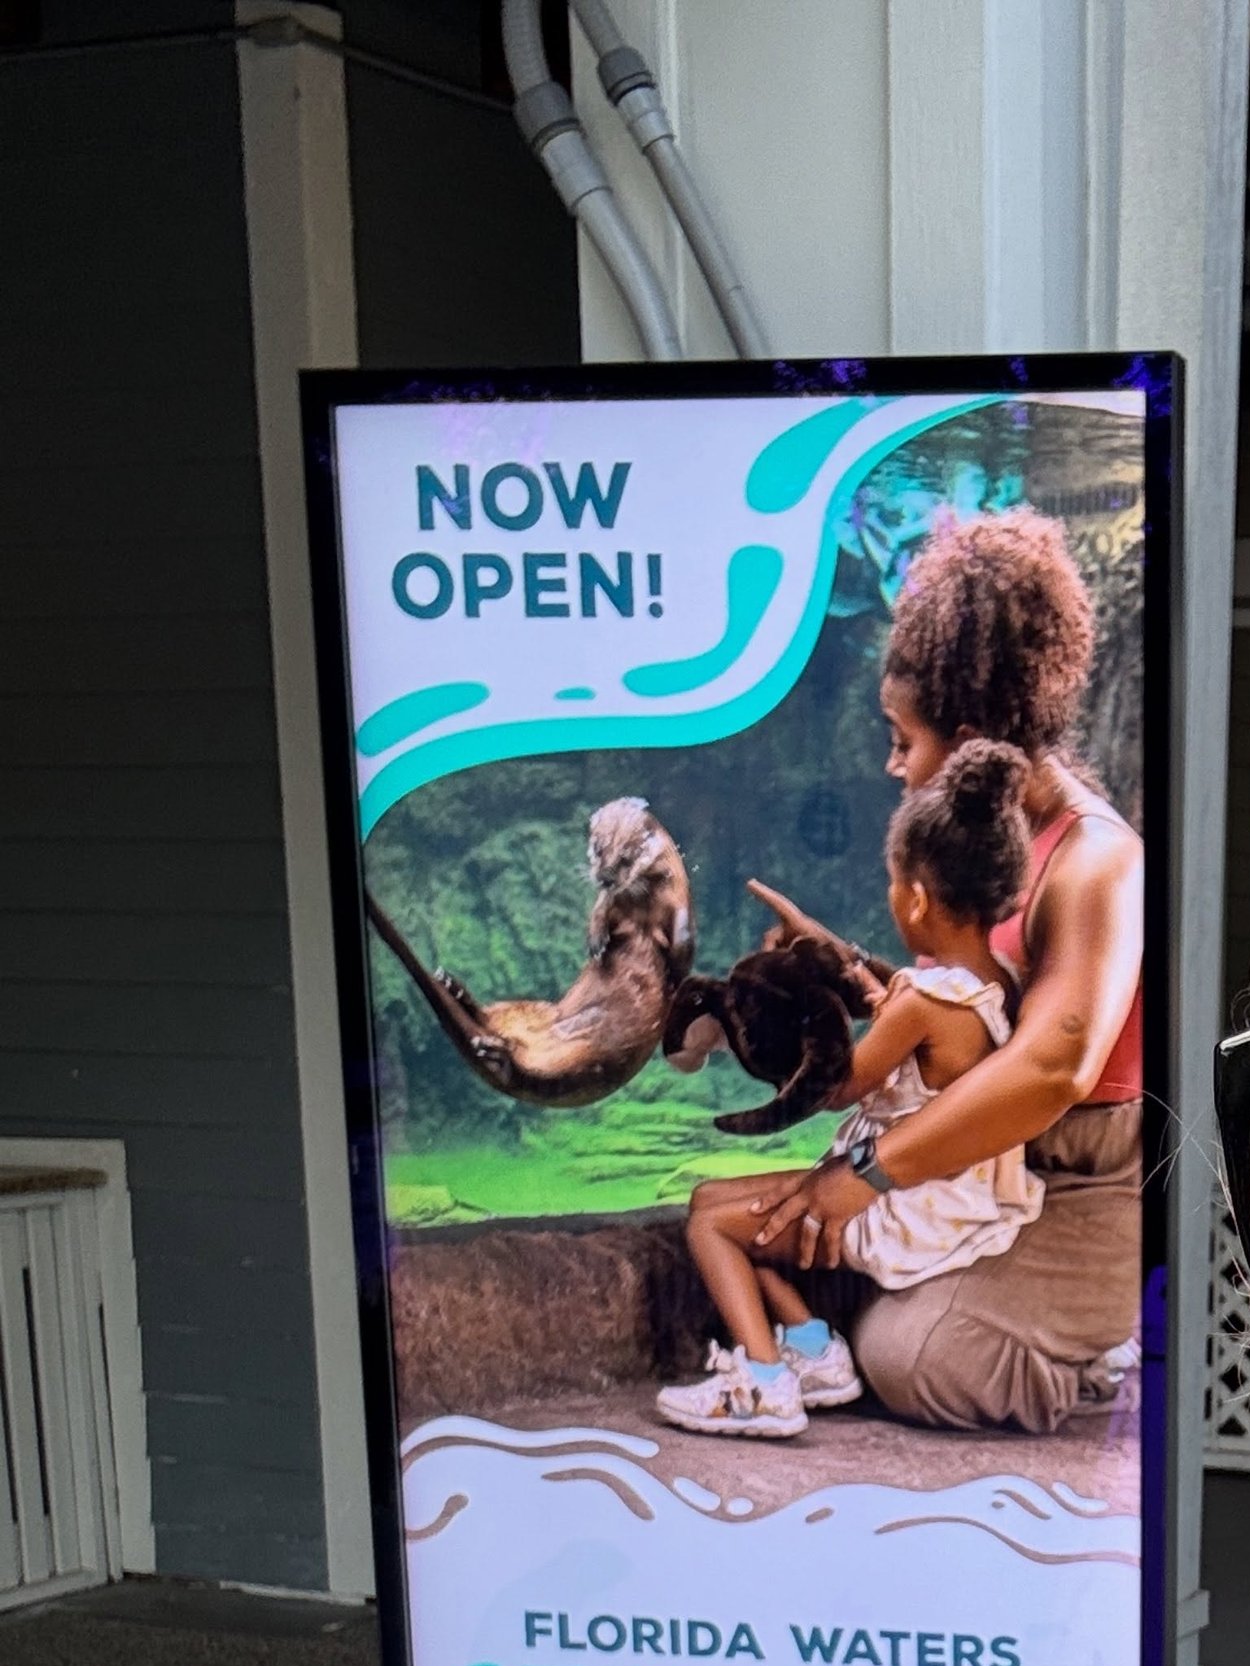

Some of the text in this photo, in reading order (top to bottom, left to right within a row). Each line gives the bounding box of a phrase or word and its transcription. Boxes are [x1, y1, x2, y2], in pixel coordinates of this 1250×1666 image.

[416, 461, 632, 531] NOW
[391, 552, 665, 619] OPEN!
[523, 1610, 765, 1661] FLORIDA
